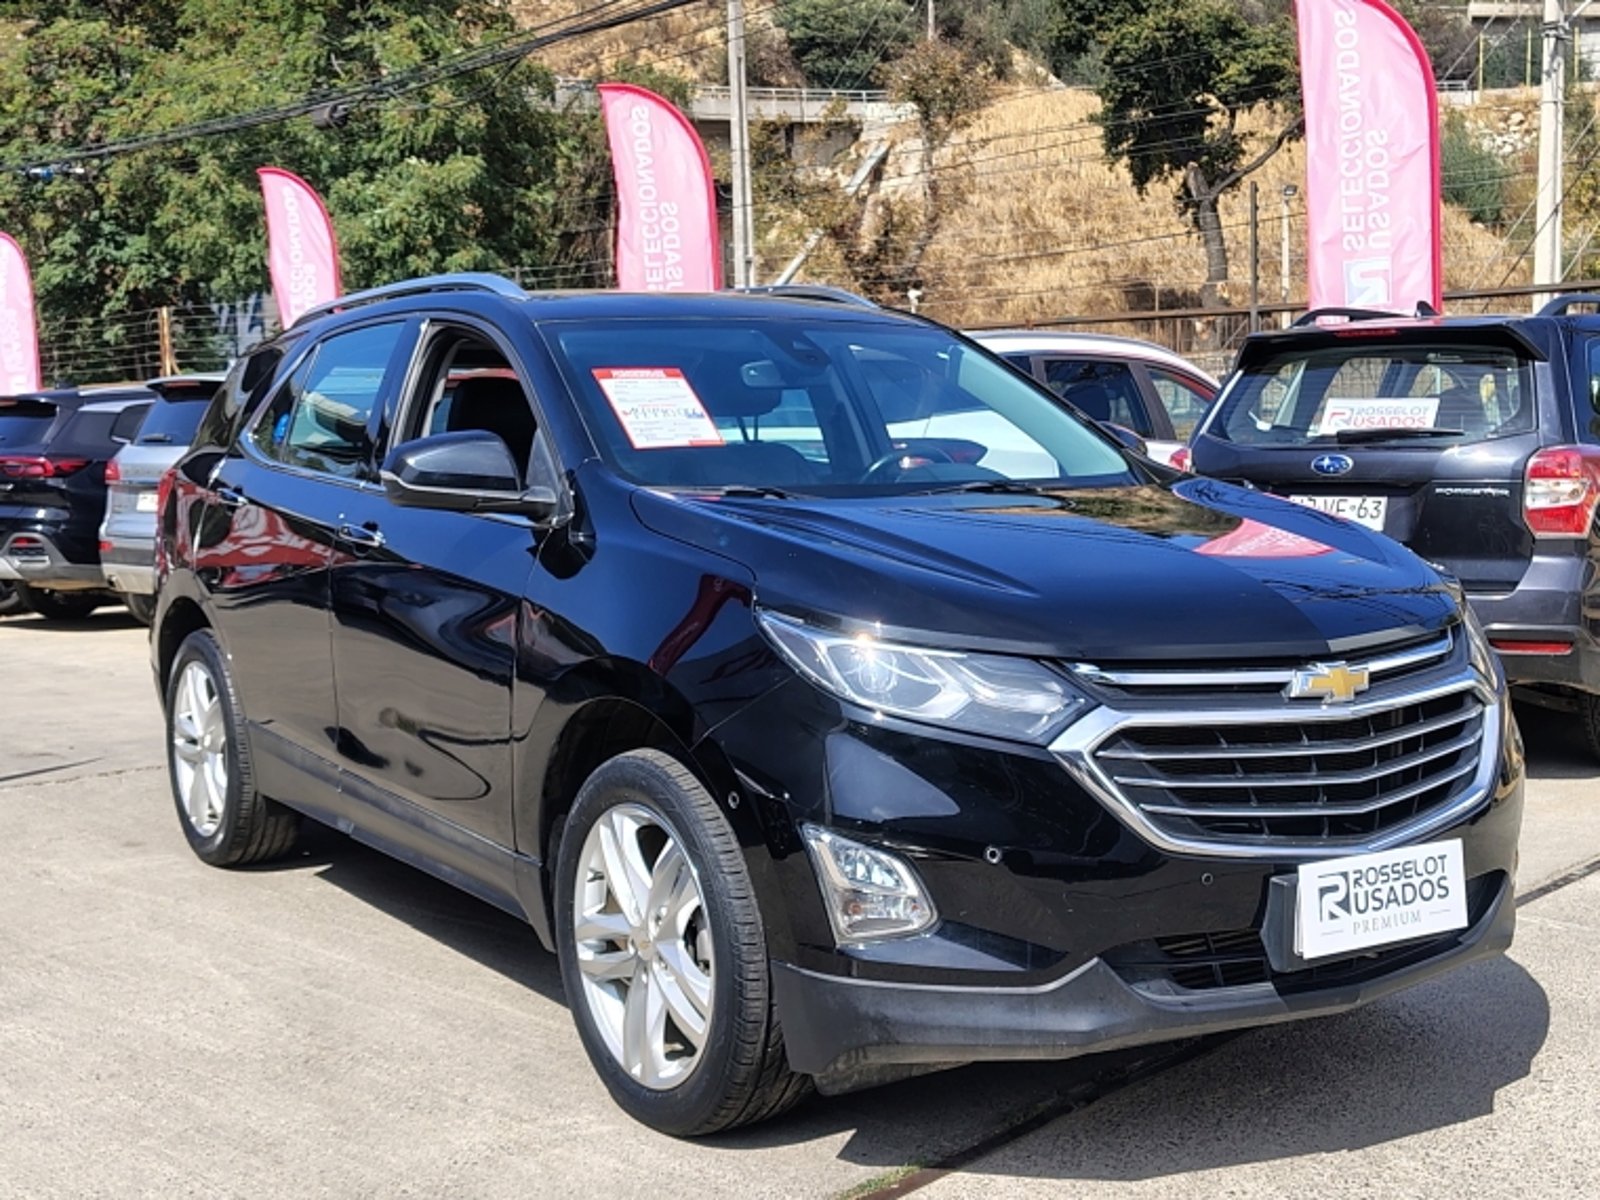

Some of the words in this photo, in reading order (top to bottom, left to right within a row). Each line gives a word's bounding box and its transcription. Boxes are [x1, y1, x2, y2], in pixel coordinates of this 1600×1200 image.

[1353, 416, 1427, 428] USADOS
[1354, 405, 1430, 416] ROSSELOT
[1352, 854, 1448, 889] ROSSELOT
[1354, 876, 1450, 915] USADOS
[1353, 909, 1422, 936] PREMIUM
